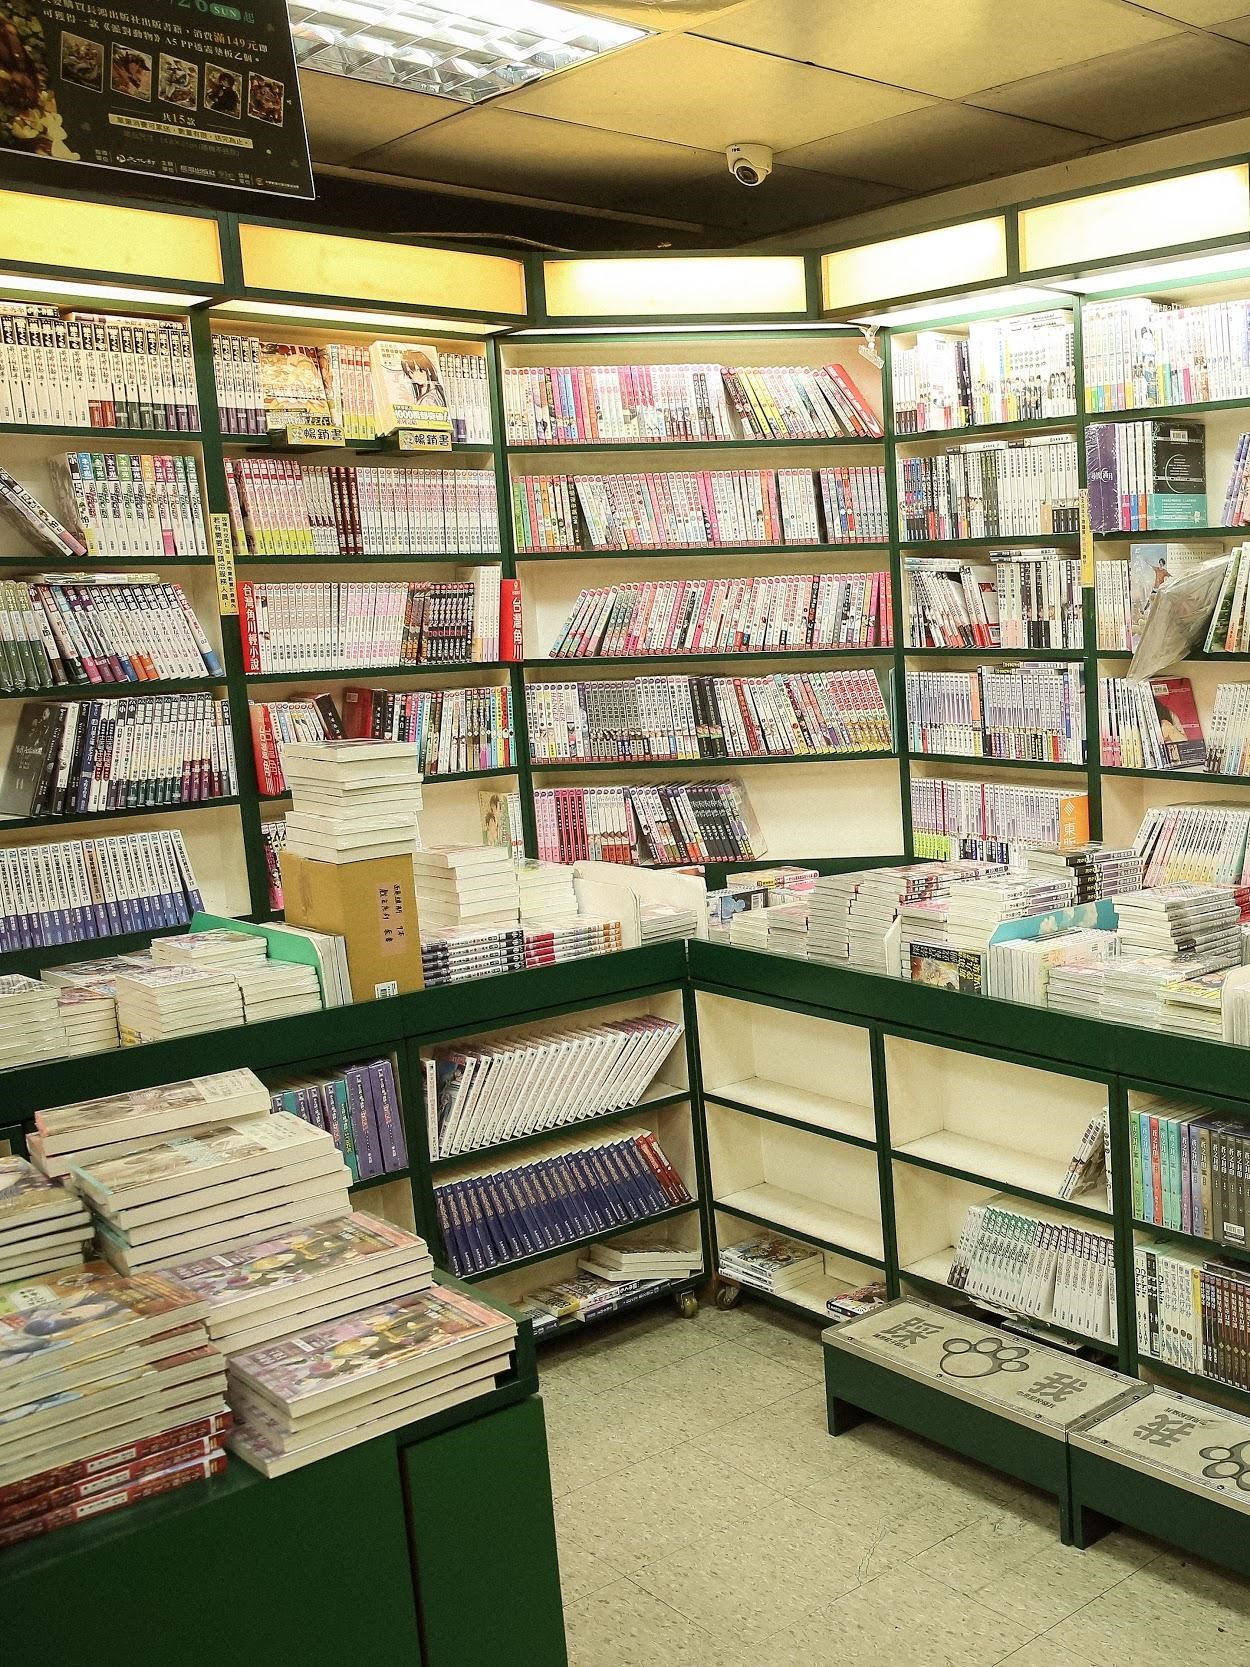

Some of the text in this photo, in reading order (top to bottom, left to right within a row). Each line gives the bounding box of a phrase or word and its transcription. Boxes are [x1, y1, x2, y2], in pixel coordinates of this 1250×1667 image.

[304, 427, 343, 441] 暢銷書
[415, 434, 450, 447] 暢銷書
[242, 582, 260, 671] 台灣角川輕小說
[512, 595, 524, 660] 台灣角川
[881, 1317, 1087, 1402] 踩 我
[1133, 1414, 1198, 1448] 我
